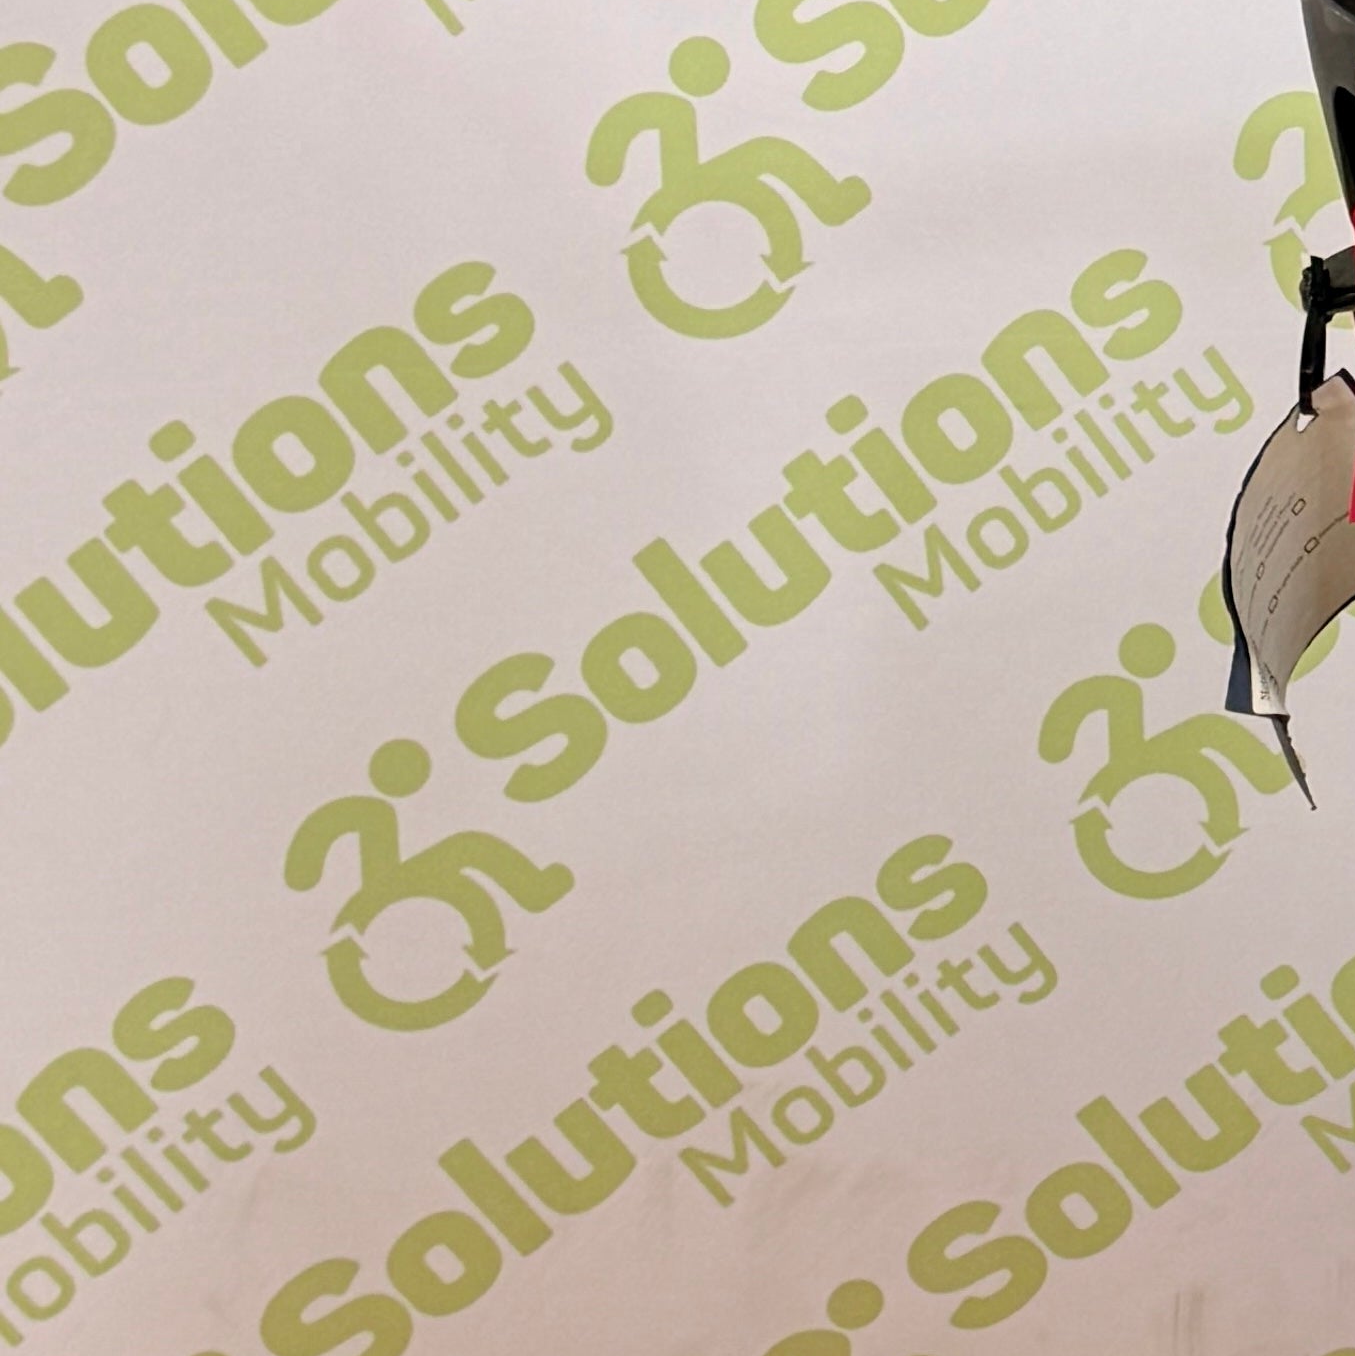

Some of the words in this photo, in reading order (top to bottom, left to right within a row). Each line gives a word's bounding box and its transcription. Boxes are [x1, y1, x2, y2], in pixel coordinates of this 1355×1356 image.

[0, 261, 535, 749] lutions
[205, 360, 612, 668] Mobility
[455, 248, 1183, 802] Solutions
[873, 345, 1255, 630] Mobility
[0, 1066, 317, 1346] obility
[678, 922, 1058, 1207] Mobility
